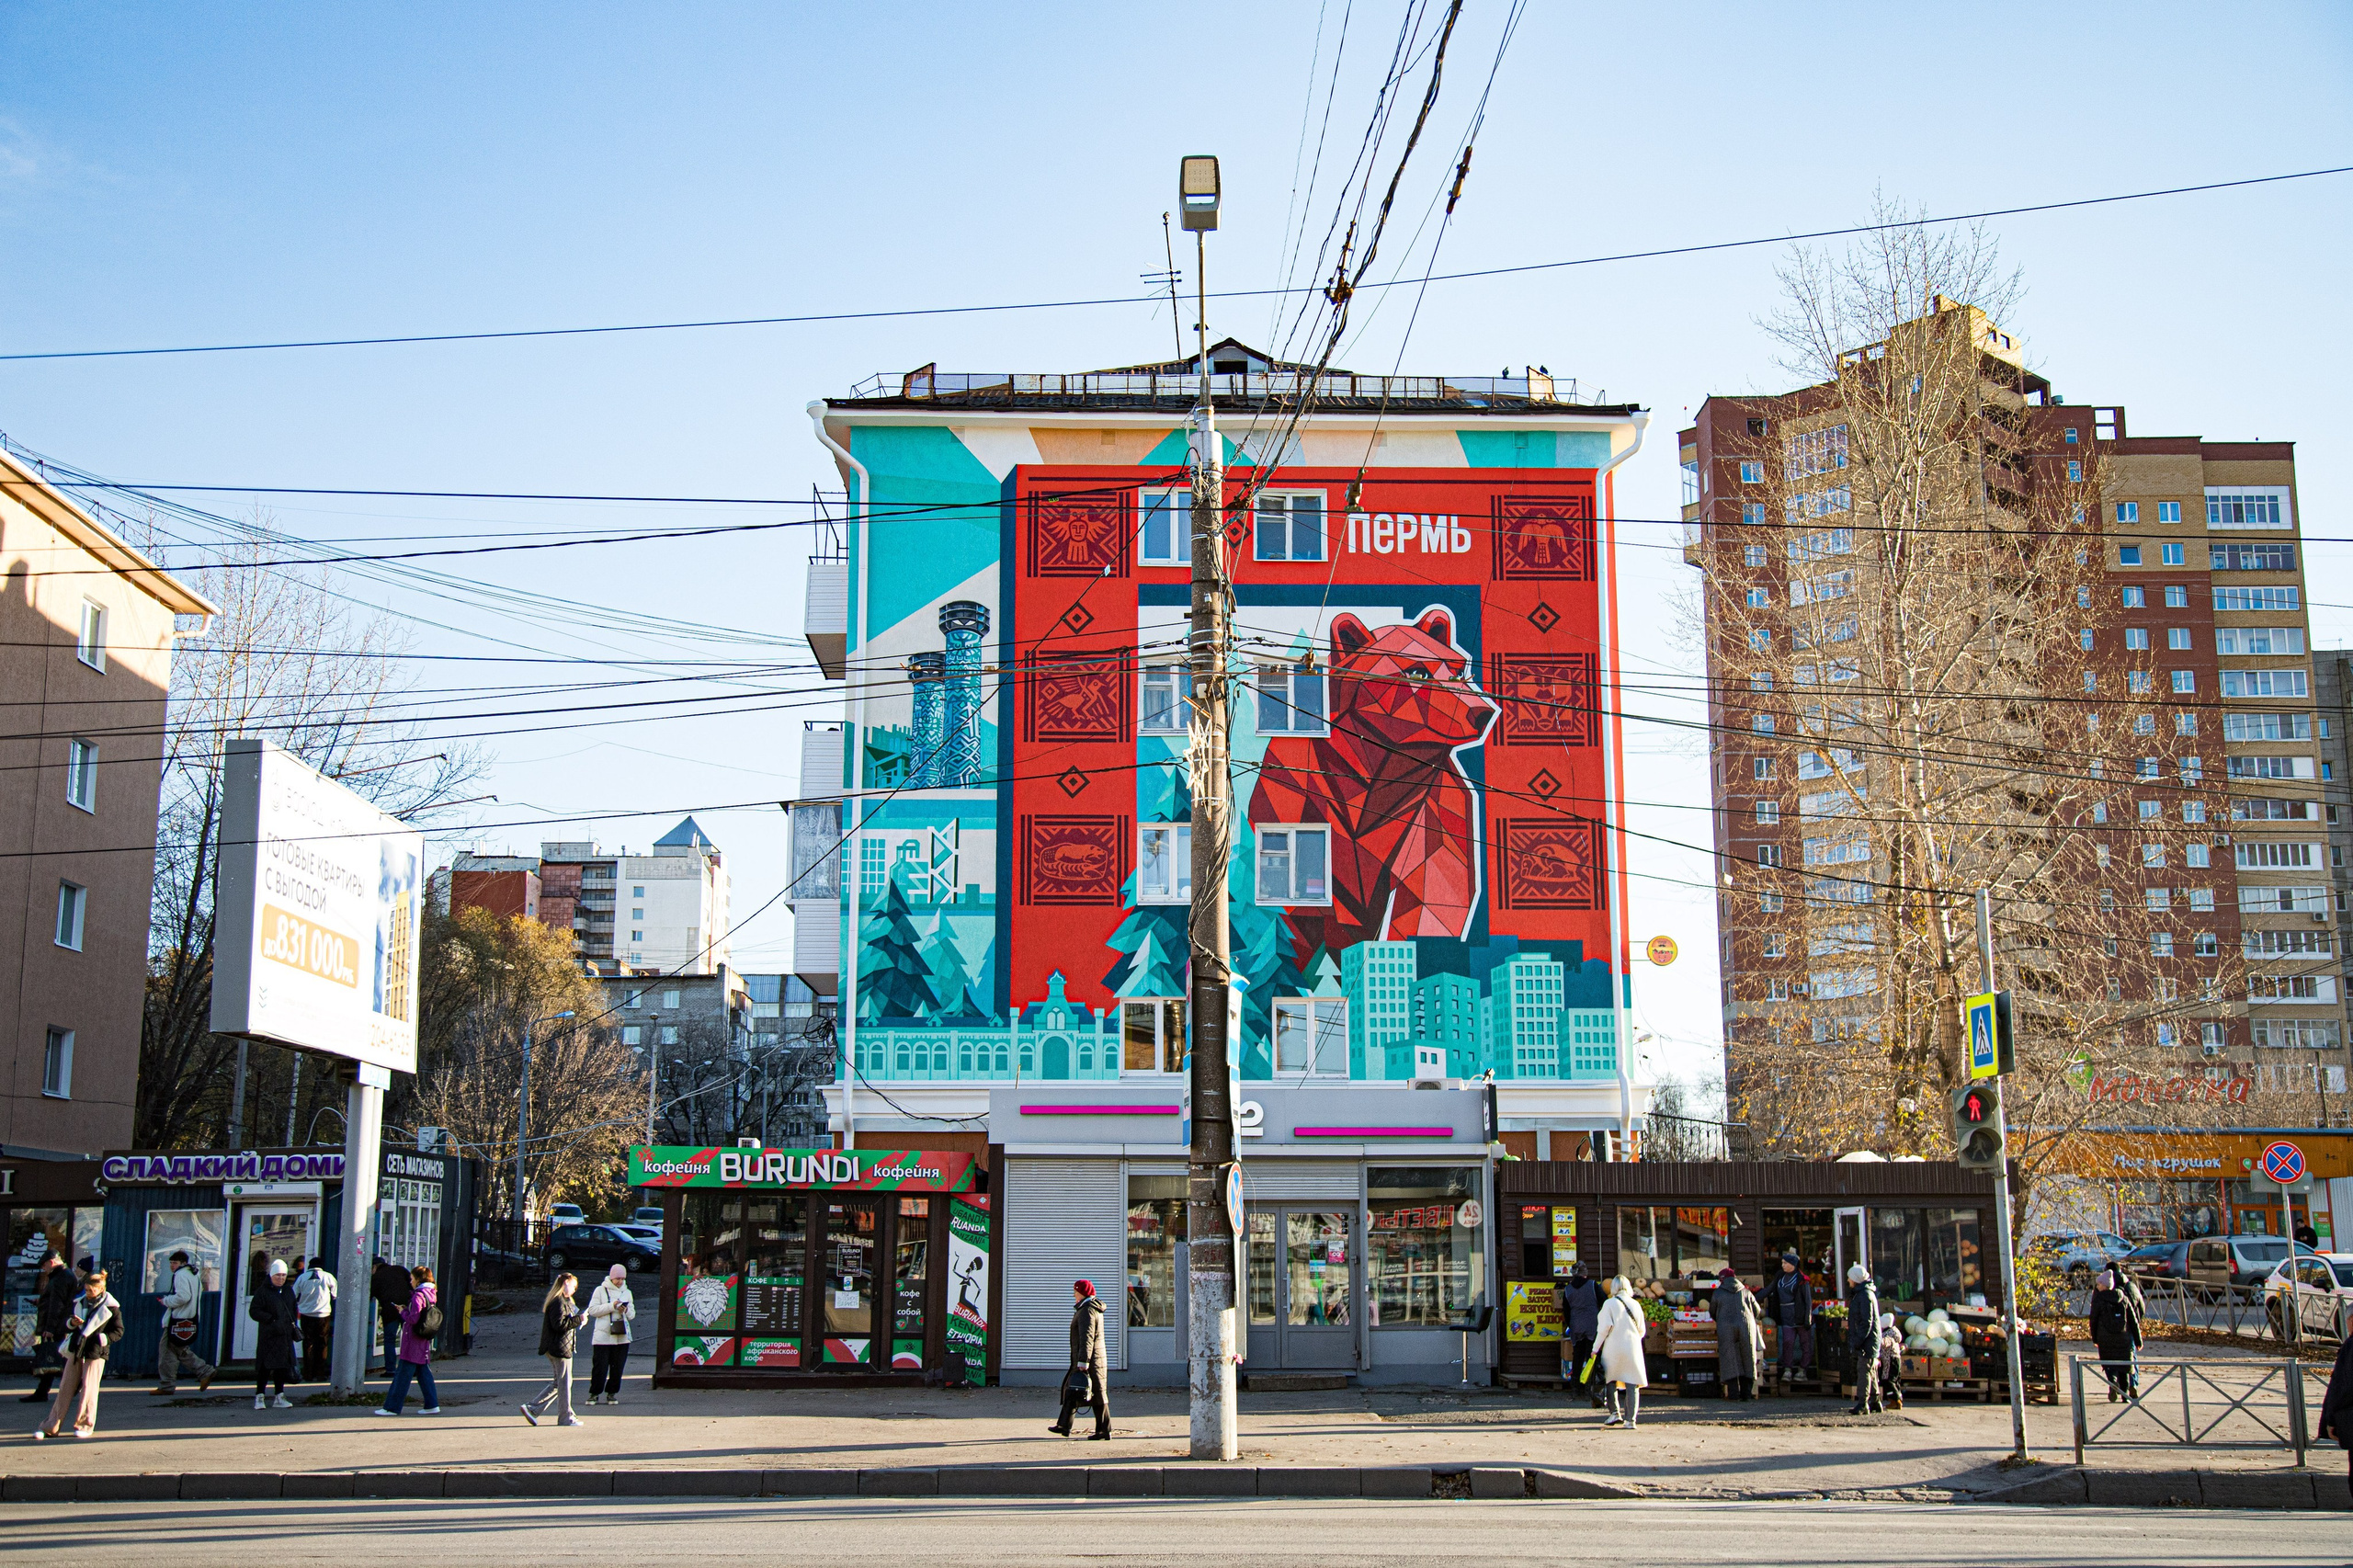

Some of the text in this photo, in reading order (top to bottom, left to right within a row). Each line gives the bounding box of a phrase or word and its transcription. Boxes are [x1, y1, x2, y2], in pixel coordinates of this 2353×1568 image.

[266, 832, 366, 899] ГОТОВЫЕ КВАРТИРЫ
[266, 867, 327, 914] С ВЫГОДОЙ
[276, 915, 307, 967] 831
[311, 928, 345, 980] 000
[103, 1151, 347, 1184] СЛАДКИЙ ДОМИ
[387, 1153, 444, 1178] СЕТЬ МАГАЗИНОВ
[643, 1160, 710, 1176] кофейня
[721, 1153, 860, 1185] BURUNDI
[873, 1164, 939, 1181] кофейня
[950, 1216, 986, 1232] RUANDA
[952, 1208, 986, 1224] UGANDA
[900, 1289, 920, 1299] кофе
[897, 1307, 921, 1315] собой
[954, 1304, 985, 1328] BURUNDI
[947, 1328, 983, 1346] ETHIOPIA
[950, 1314, 983, 1337] KENYA
[683, 1337, 719, 1363] BURUNDI
[965, 1358, 983, 1367] NDA
